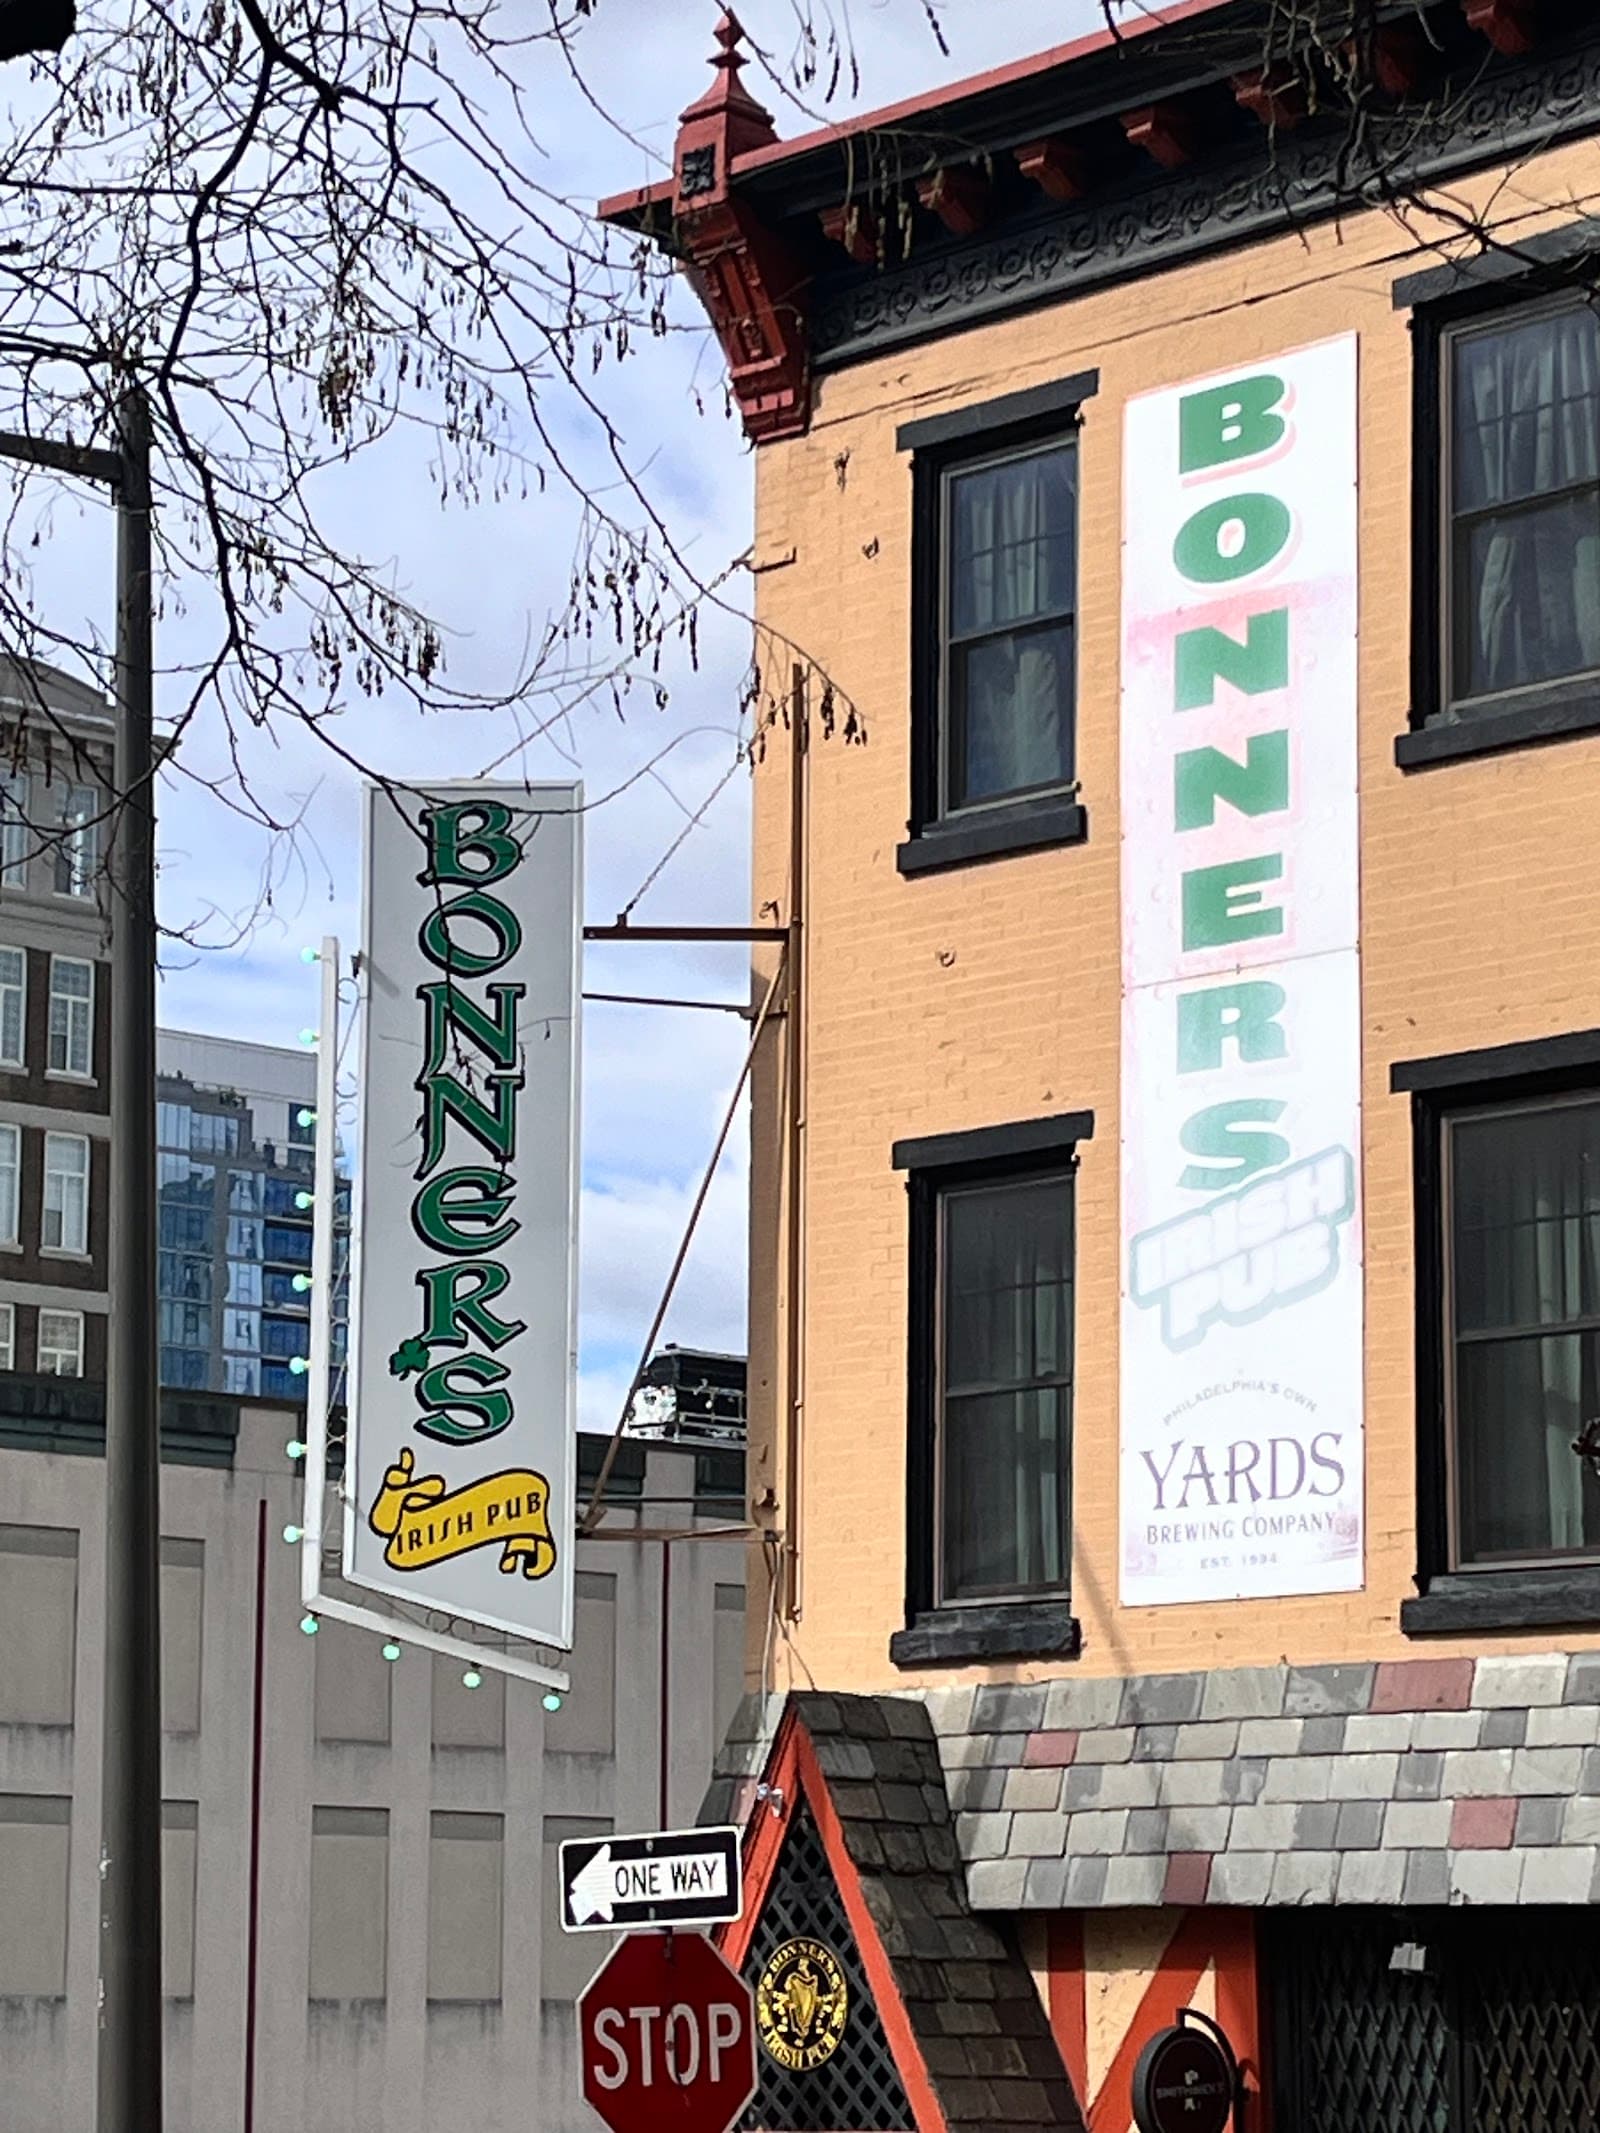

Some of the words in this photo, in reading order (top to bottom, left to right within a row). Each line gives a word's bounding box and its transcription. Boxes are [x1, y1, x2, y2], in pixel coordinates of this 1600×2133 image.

[1173, 374, 1291, 1190] BONNERS
[411, 800, 527, 1446] BONNERS
[1283, 1387, 1318, 1413] OWN
[1139, 1432, 1345, 1510] YARDS
[397, 1511, 474, 1555] IRISH
[487, 1492, 541, 1526] PUB
[1147, 1519, 1234, 1545] BREWING
[1242, 1511, 1336, 1538] COMPANY
[614, 1862, 661, 1898] ONE
[671, 1857, 718, 1893] WAY
[593, 2002, 742, 2090] STOP
